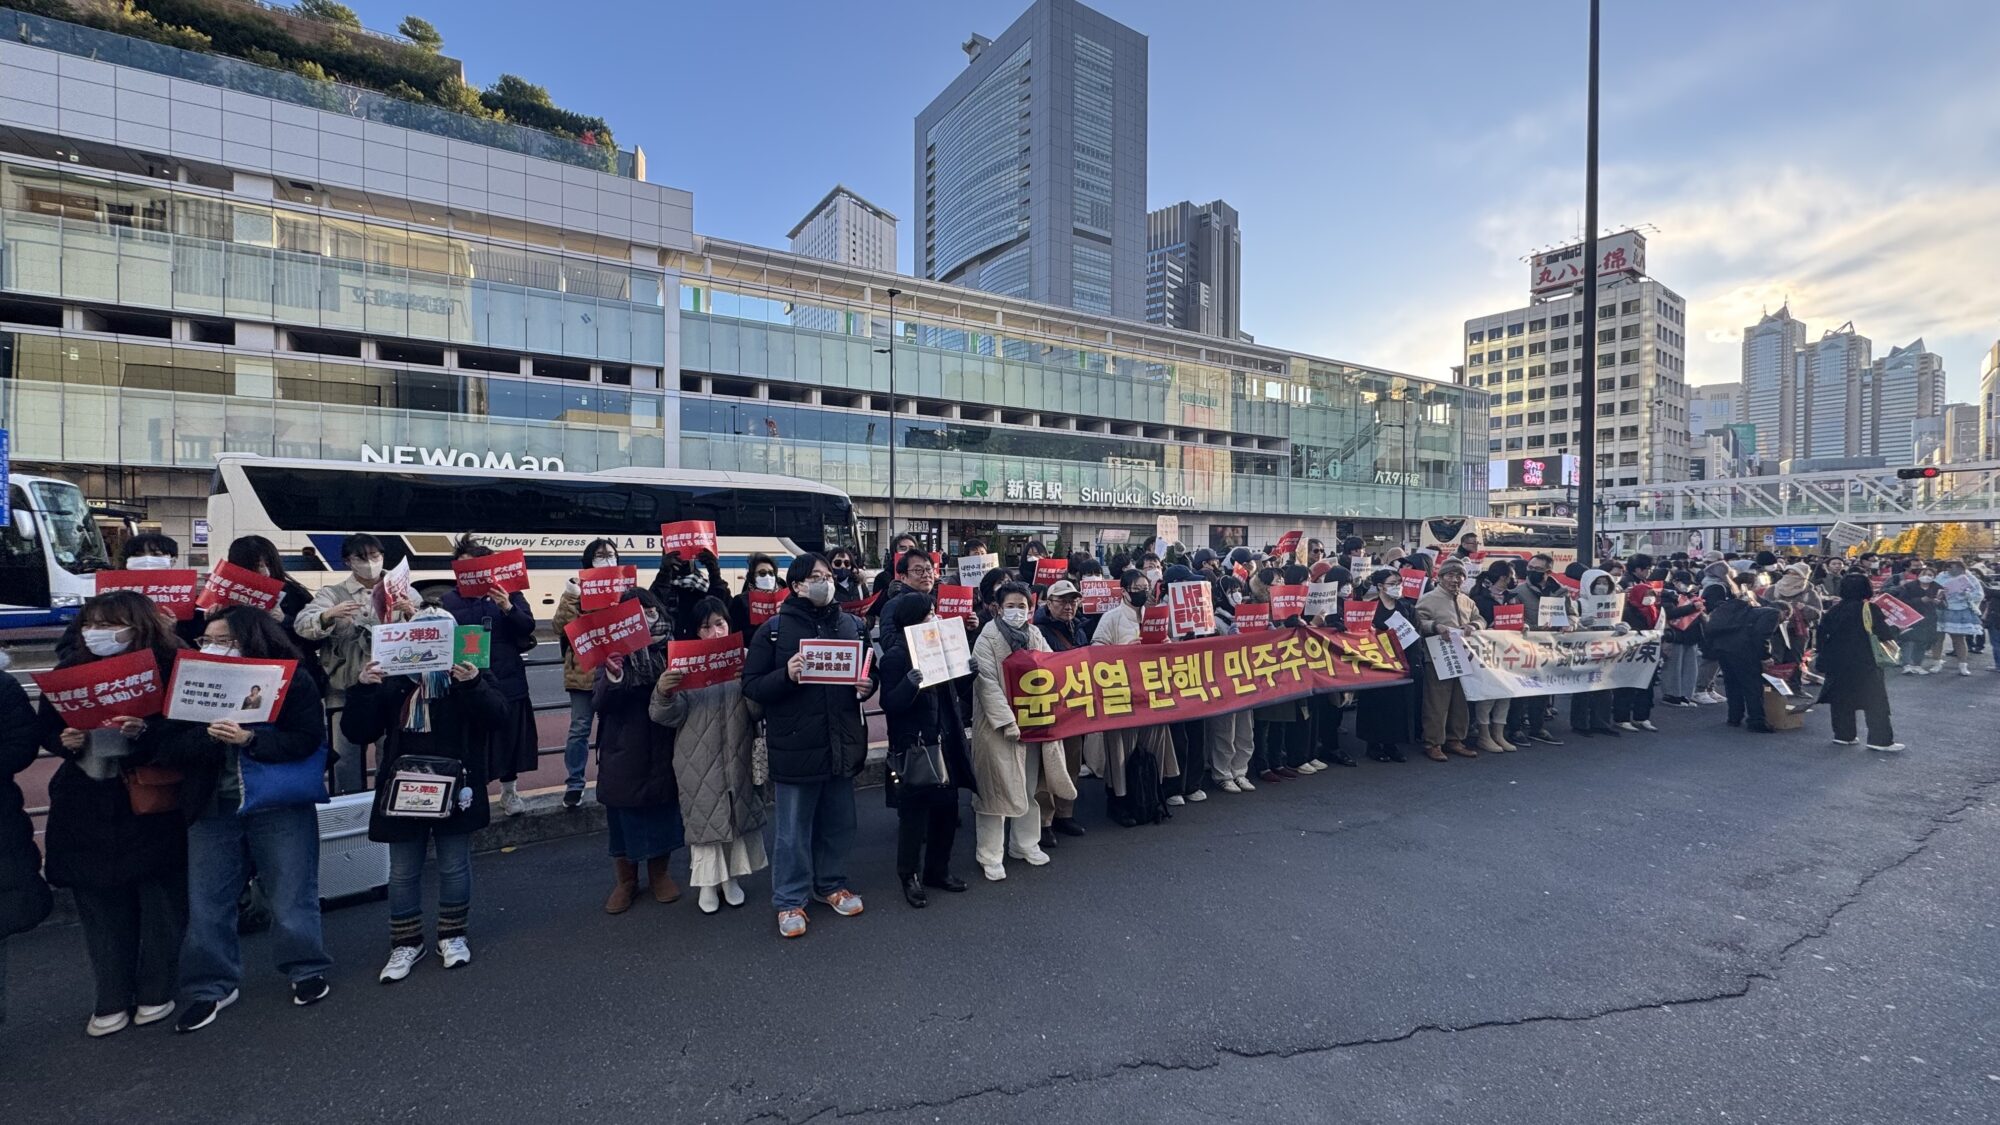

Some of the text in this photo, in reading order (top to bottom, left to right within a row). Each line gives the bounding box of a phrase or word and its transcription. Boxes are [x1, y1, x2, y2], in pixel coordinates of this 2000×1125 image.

[1536, 247, 1627, 286] 丸八綿
[1526, 460, 1541, 470] SAT
[960, 479, 1195, 507] JR 新宿駅 Shinjuku Station
[481, 536, 535, 550] Highway
[541, 537, 586, 550] Express
[806, 651, 832, 660] 윤석열
[1013, 659, 1133, 727] 윤석열
[1139, 650, 1222, 709] 탄핵!
[1224, 637, 1336, 695] 민주주의
[44, 686, 88, 702] 乱首魁
